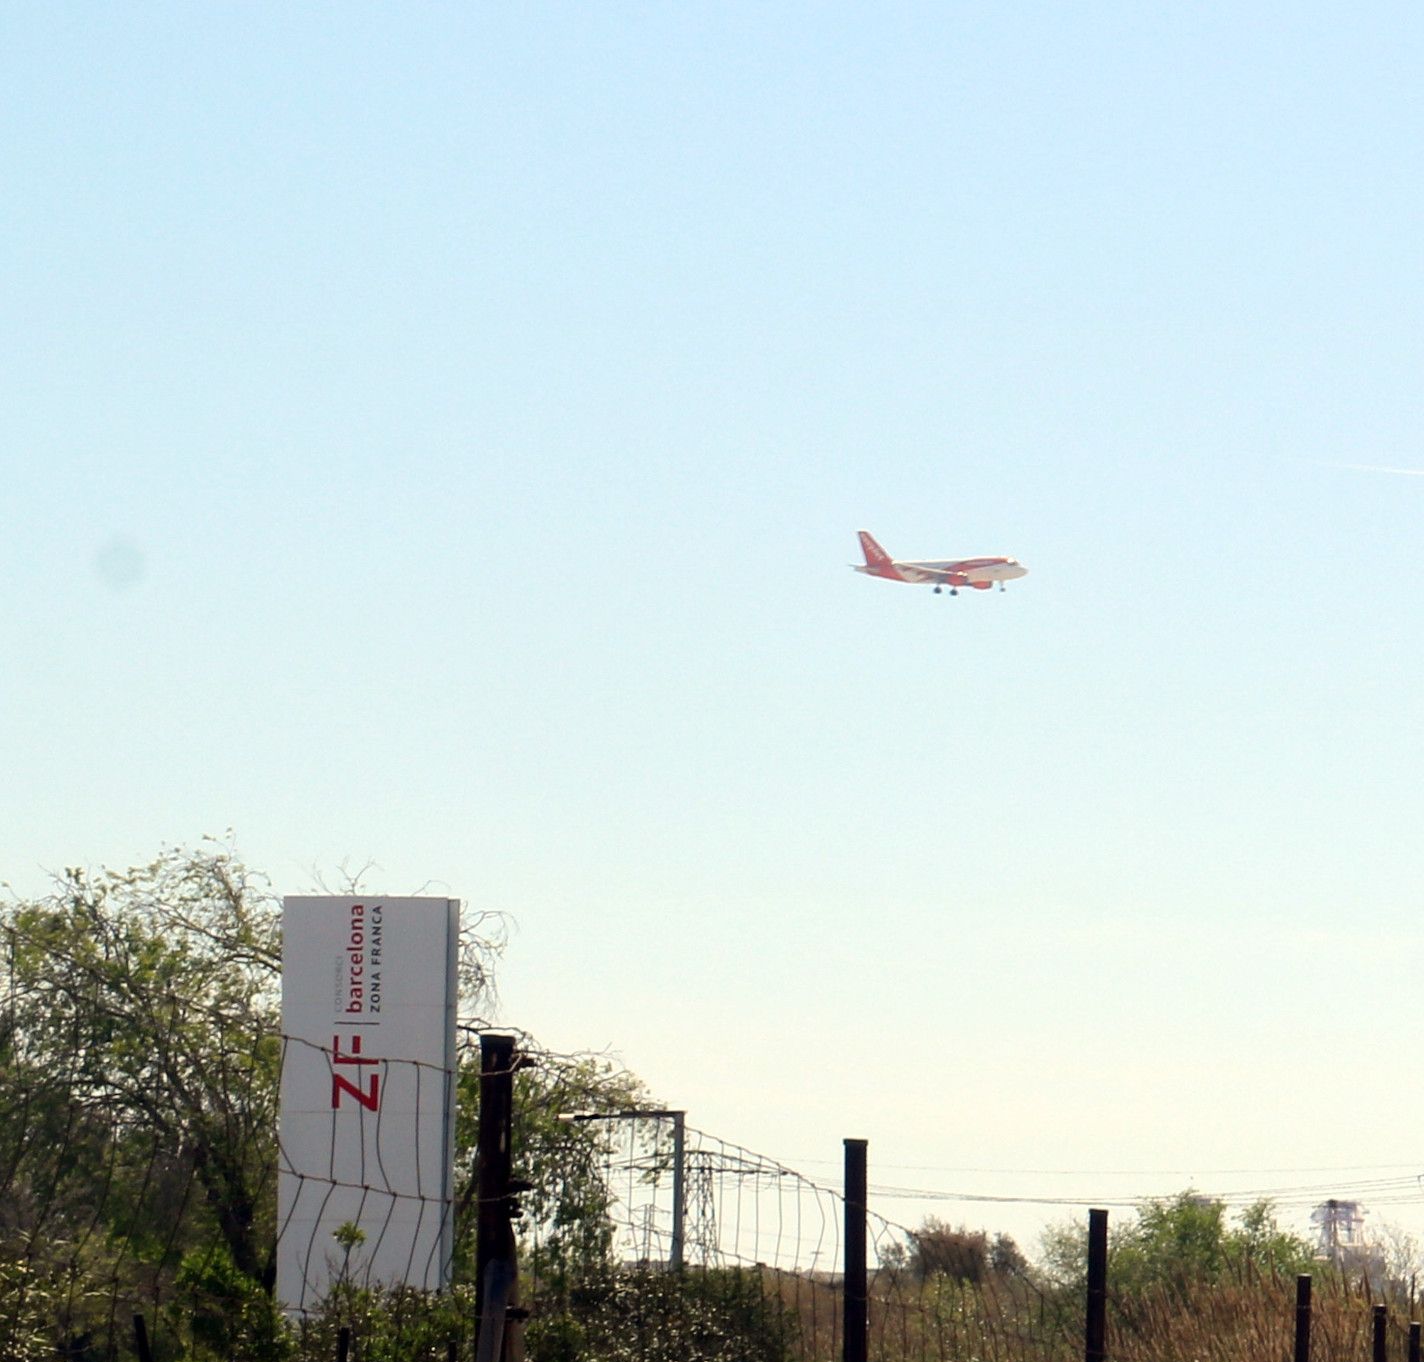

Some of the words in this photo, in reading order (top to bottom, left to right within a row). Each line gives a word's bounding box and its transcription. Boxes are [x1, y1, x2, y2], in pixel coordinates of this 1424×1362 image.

[346, 905, 364, 1013] barcelona
[371, 905, 383, 965] FRANCA
[370, 972, 381, 1013] ZONA
[332, 1035, 379, 1112] ZF
